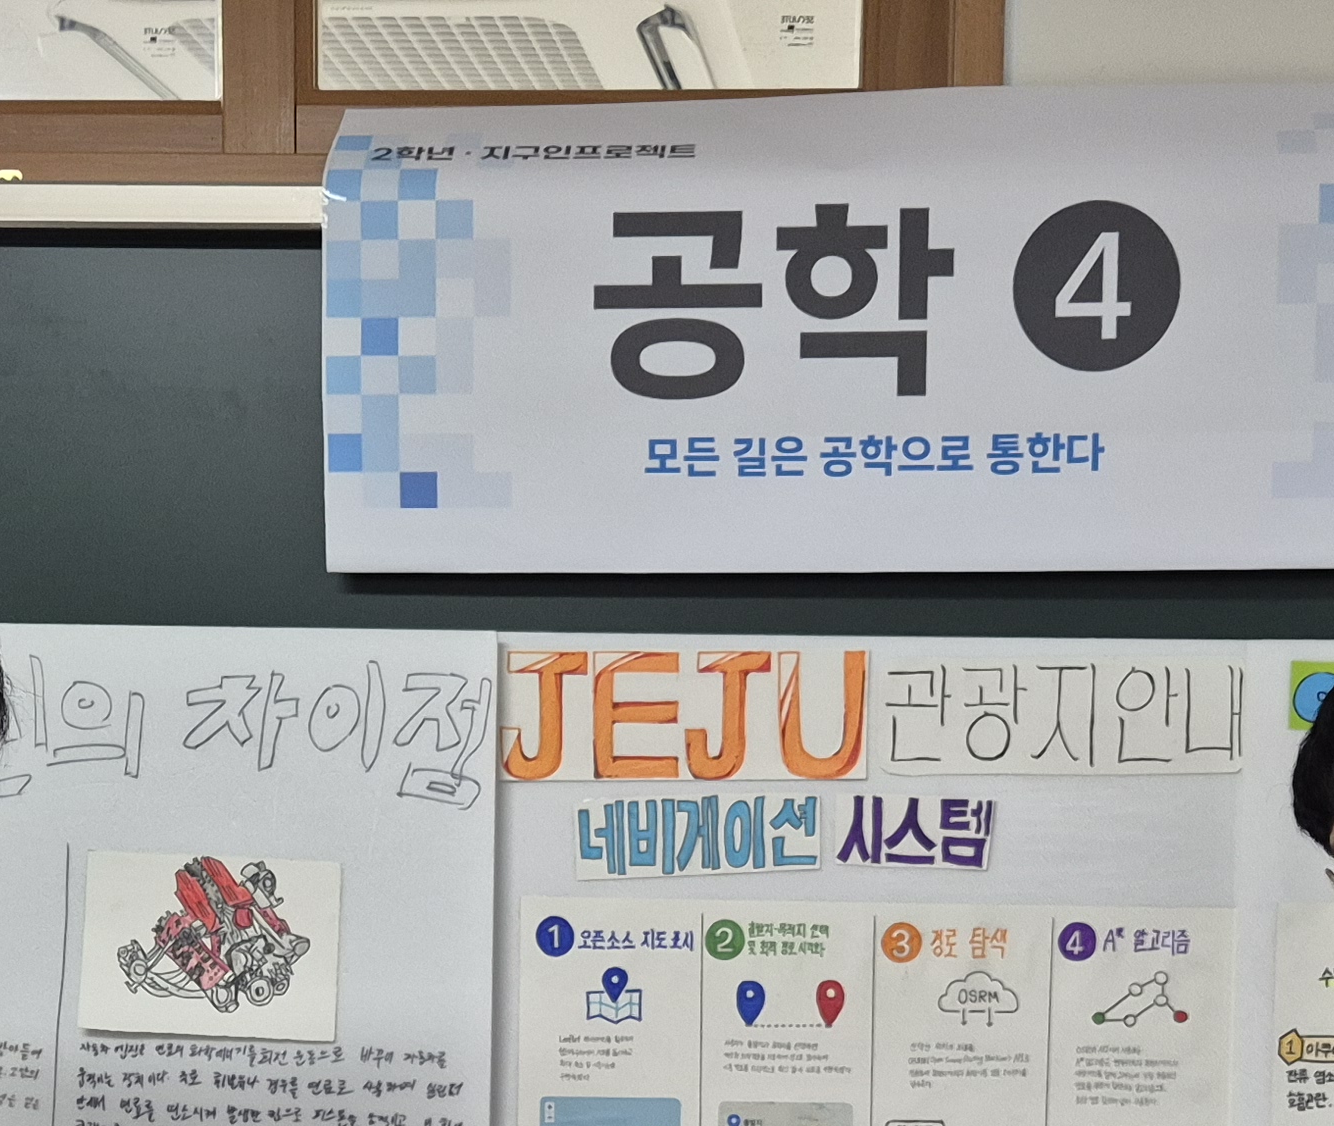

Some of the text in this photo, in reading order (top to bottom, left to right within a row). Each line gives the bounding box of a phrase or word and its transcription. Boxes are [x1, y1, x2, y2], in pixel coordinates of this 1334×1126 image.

[370, 141, 698, 162] 2학년 지구인프로젝트
[593, 203, 955, 400] 공학
[643, 431, 1106, 479] 모든 길은 공학으로 통한다
[182, 660, 493, 811] 차이점
[499, 650, 1247, 781] JEJU 관광지안내
[576, 795, 994, 877] 네비게이션 시스템
[577, 929, 636, 950] 오픈소스
[640, 928, 668, 951] 지도
[969, 927, 1010, 960] 탐색
[1133, 927, 1191, 957] 알고리즘
[958, 988, 1000, 1005] OSRM
